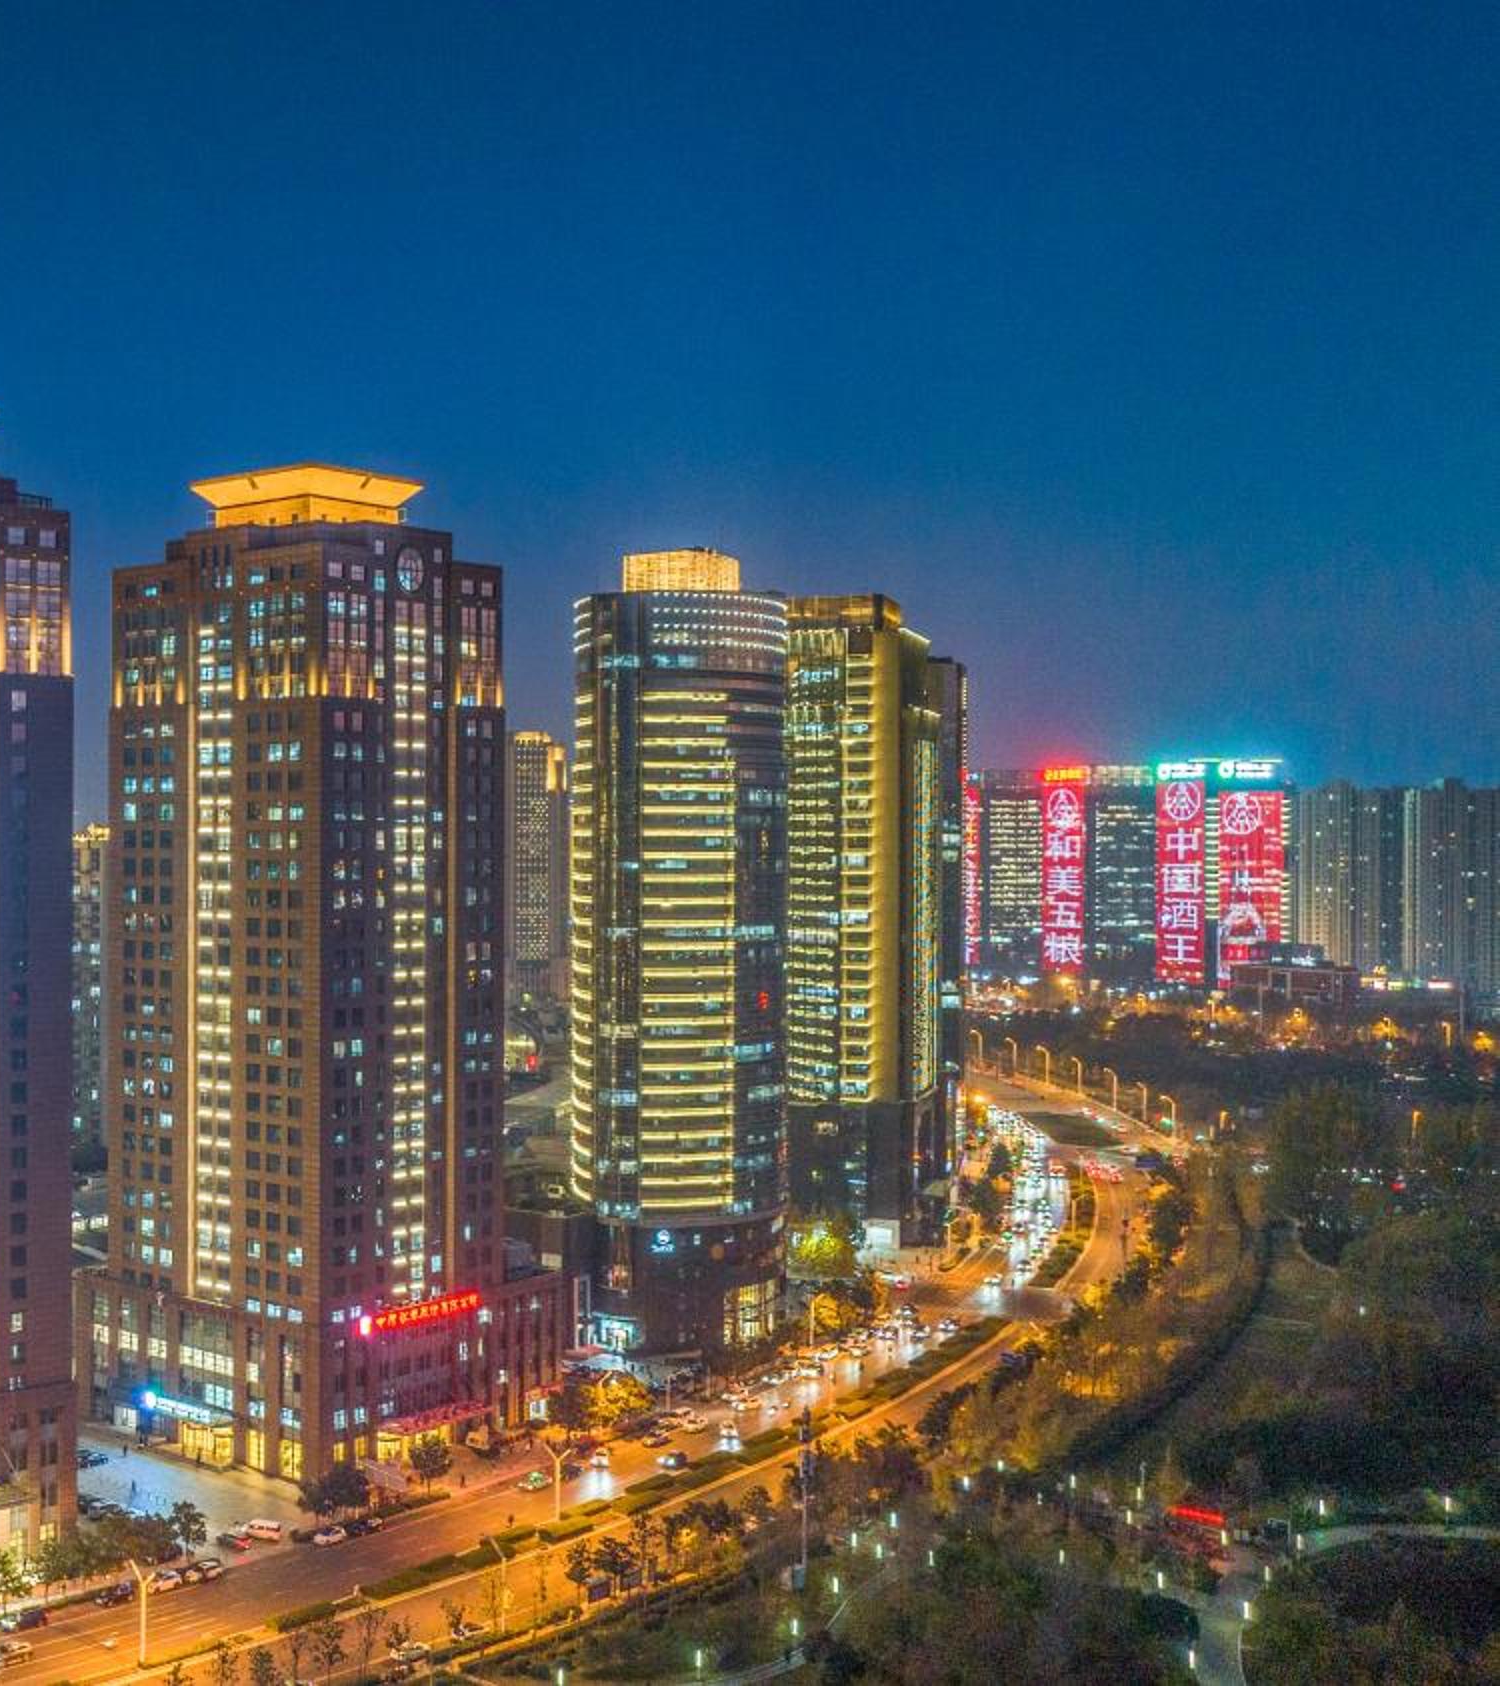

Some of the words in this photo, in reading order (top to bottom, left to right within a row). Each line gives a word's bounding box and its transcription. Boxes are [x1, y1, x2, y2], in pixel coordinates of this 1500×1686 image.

[1044, 832, 1083, 964] 和美五粮
[1160, 828, 1200, 963] 中国酒王
